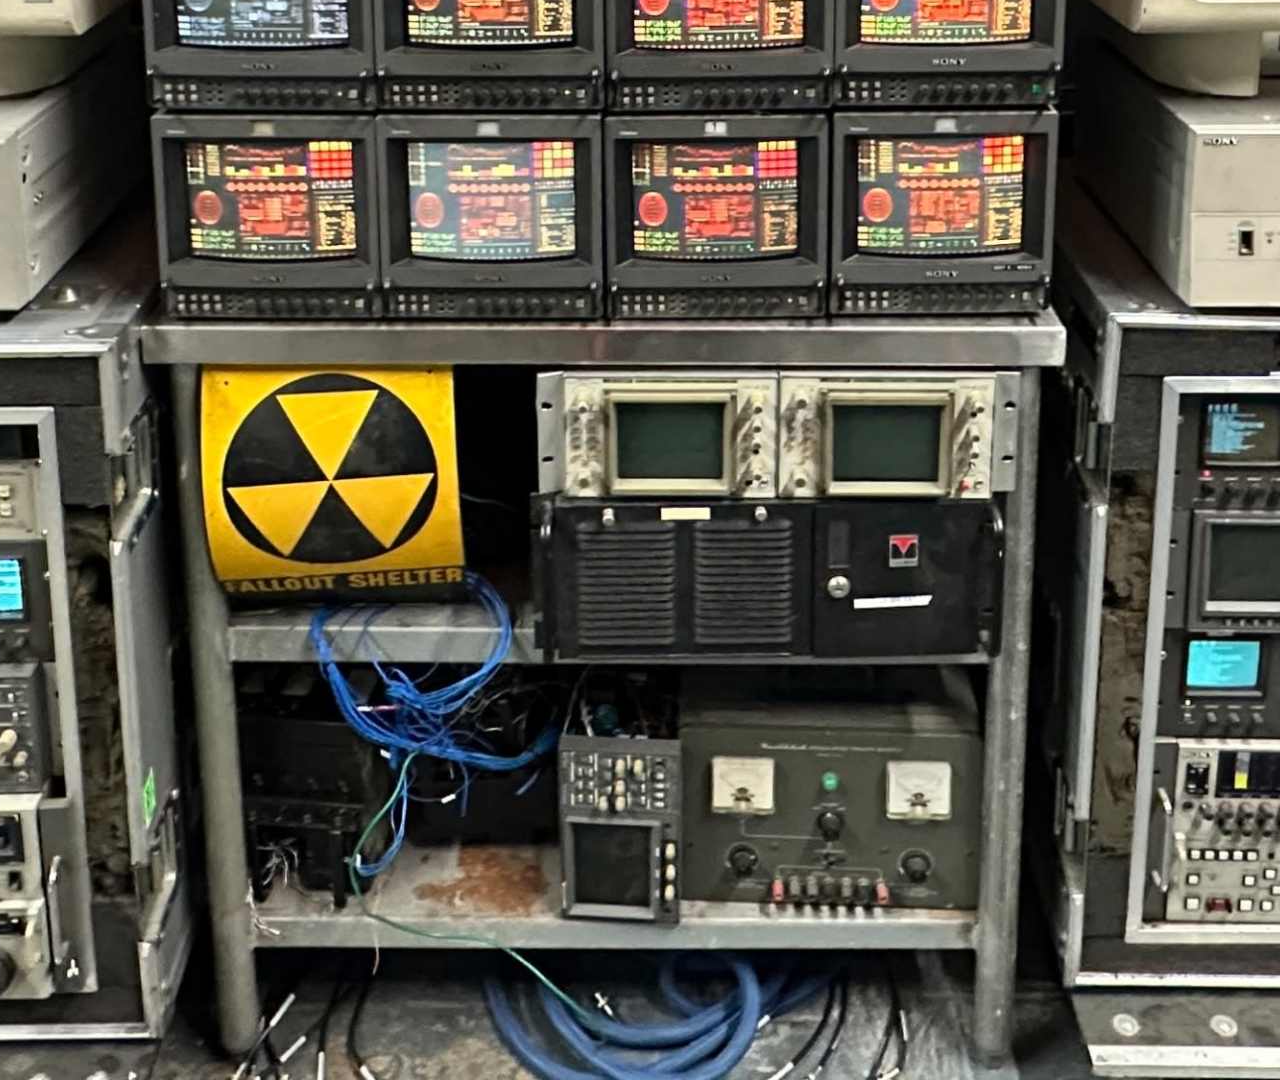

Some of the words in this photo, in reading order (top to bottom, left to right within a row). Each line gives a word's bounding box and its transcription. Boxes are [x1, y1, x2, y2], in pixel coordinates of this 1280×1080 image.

[932, 58, 967, 66] SONY
[925, 269, 960, 278] SONY
[348, 568, 463, 588] SHELTER
